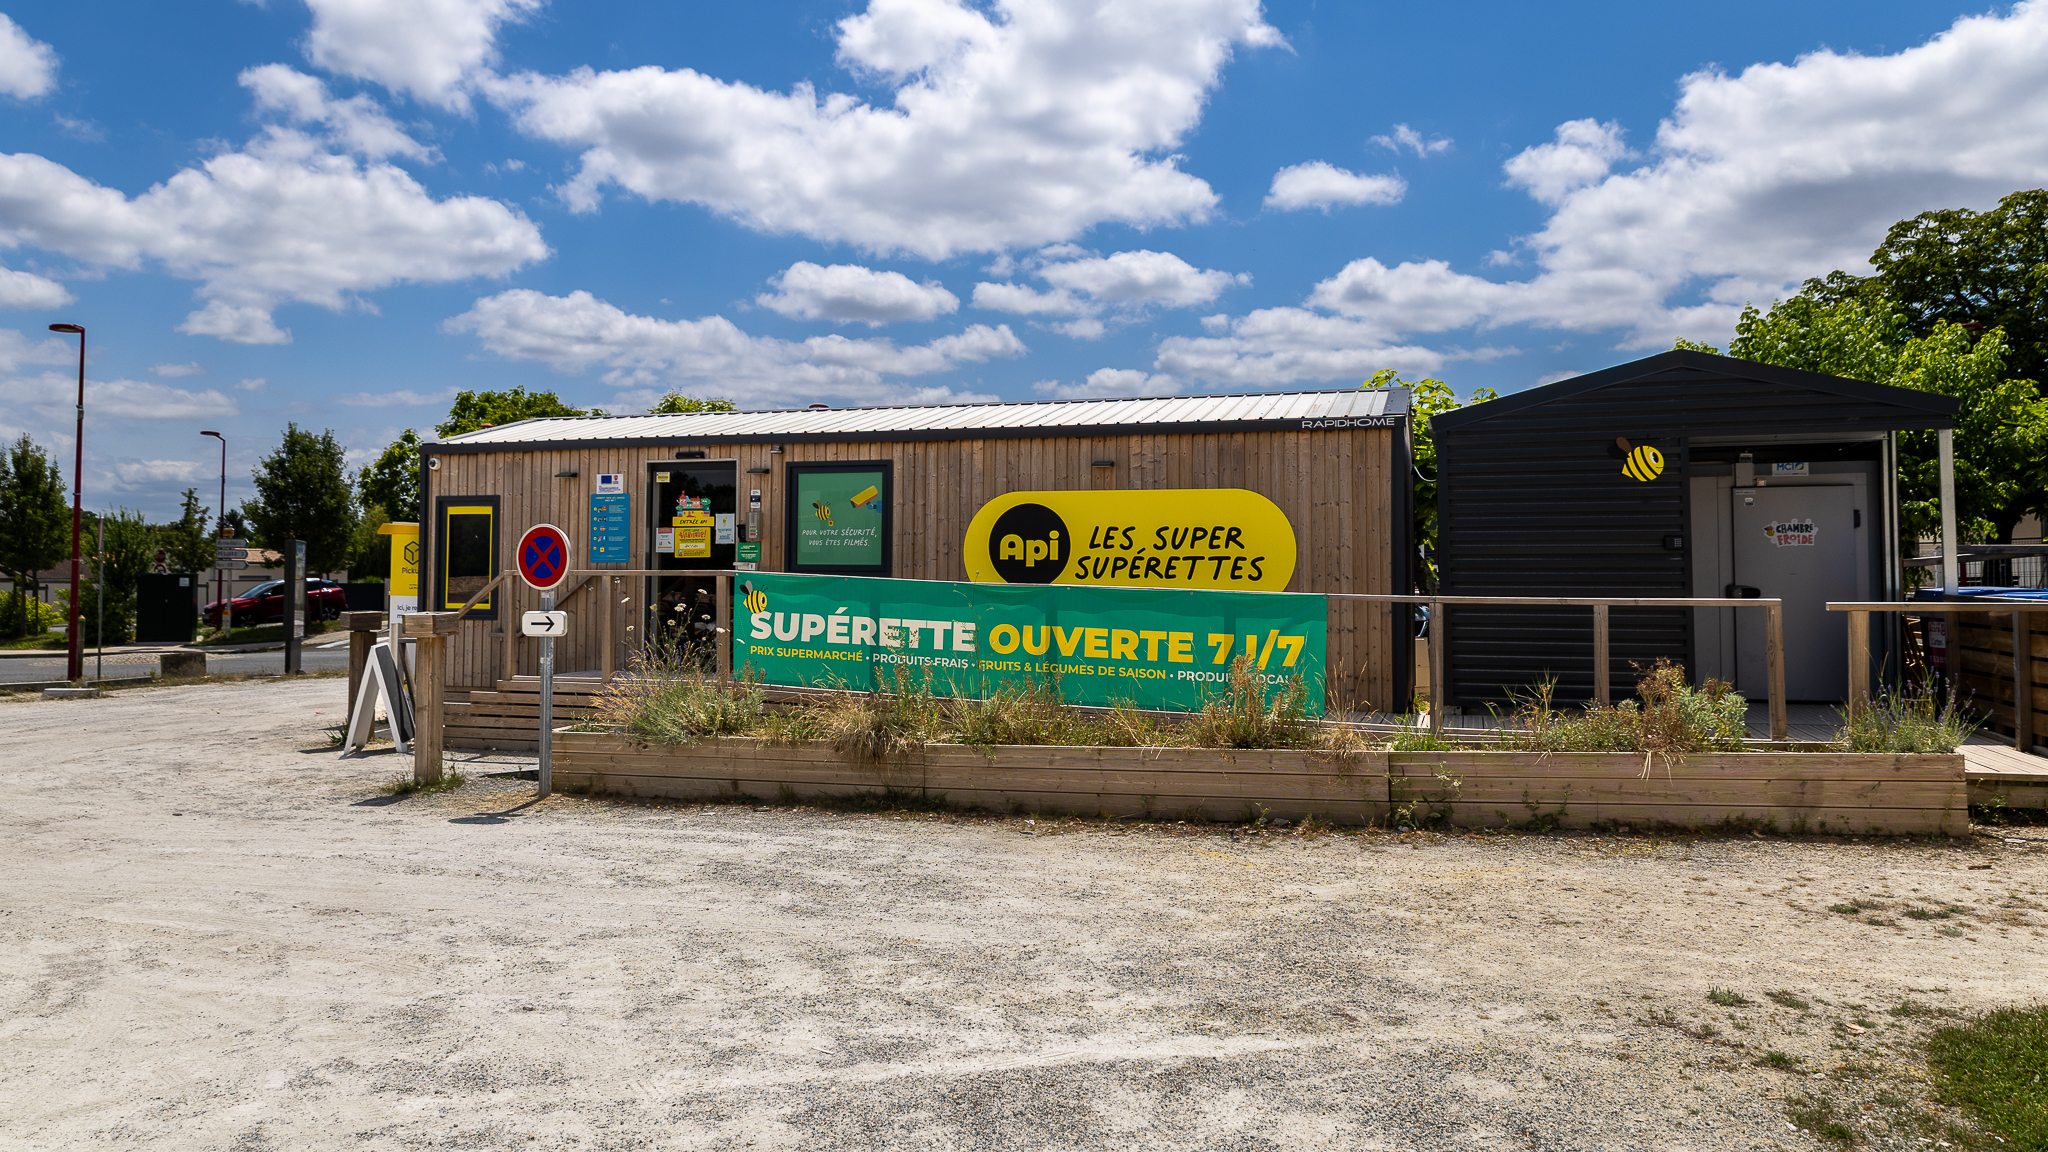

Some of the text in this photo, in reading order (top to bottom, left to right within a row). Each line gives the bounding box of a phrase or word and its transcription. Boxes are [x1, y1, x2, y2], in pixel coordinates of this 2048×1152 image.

[1302, 417, 1395, 428] RAPIDHOME
[825, 537, 841, 546] ÊTES
[843, 536, 870, 547] FILMÉS.
[841, 526, 878, 538] SÉCURITÉ,
[1088, 525, 1246, 551] LES SUPER
[1775, 523, 1814, 534] CHAMBRE
[999, 530, 1060, 568] Api
[1074, 547, 1266, 582] SUPÉRETTES
[749, 606, 977, 653] SUPÉRETTE
[989, 623, 1194, 664] OUVERTE
[750, 645, 775, 657] PRIX
[776, 646, 863, 662] SUPERMARCHÉ
[872, 653, 932, 668] PRODUITS
[934, 656, 970, 670] FRAIS
[979, 659, 1022, 672] FRUITS
[1024, 662, 1032, 672] &
[1035, 660, 1095, 676] LÉGUMES
[1098, 665, 1116, 677] DE
[1118, 667, 1167, 680] SAISON
[1177, 669, 1236, 684] PRODUI
